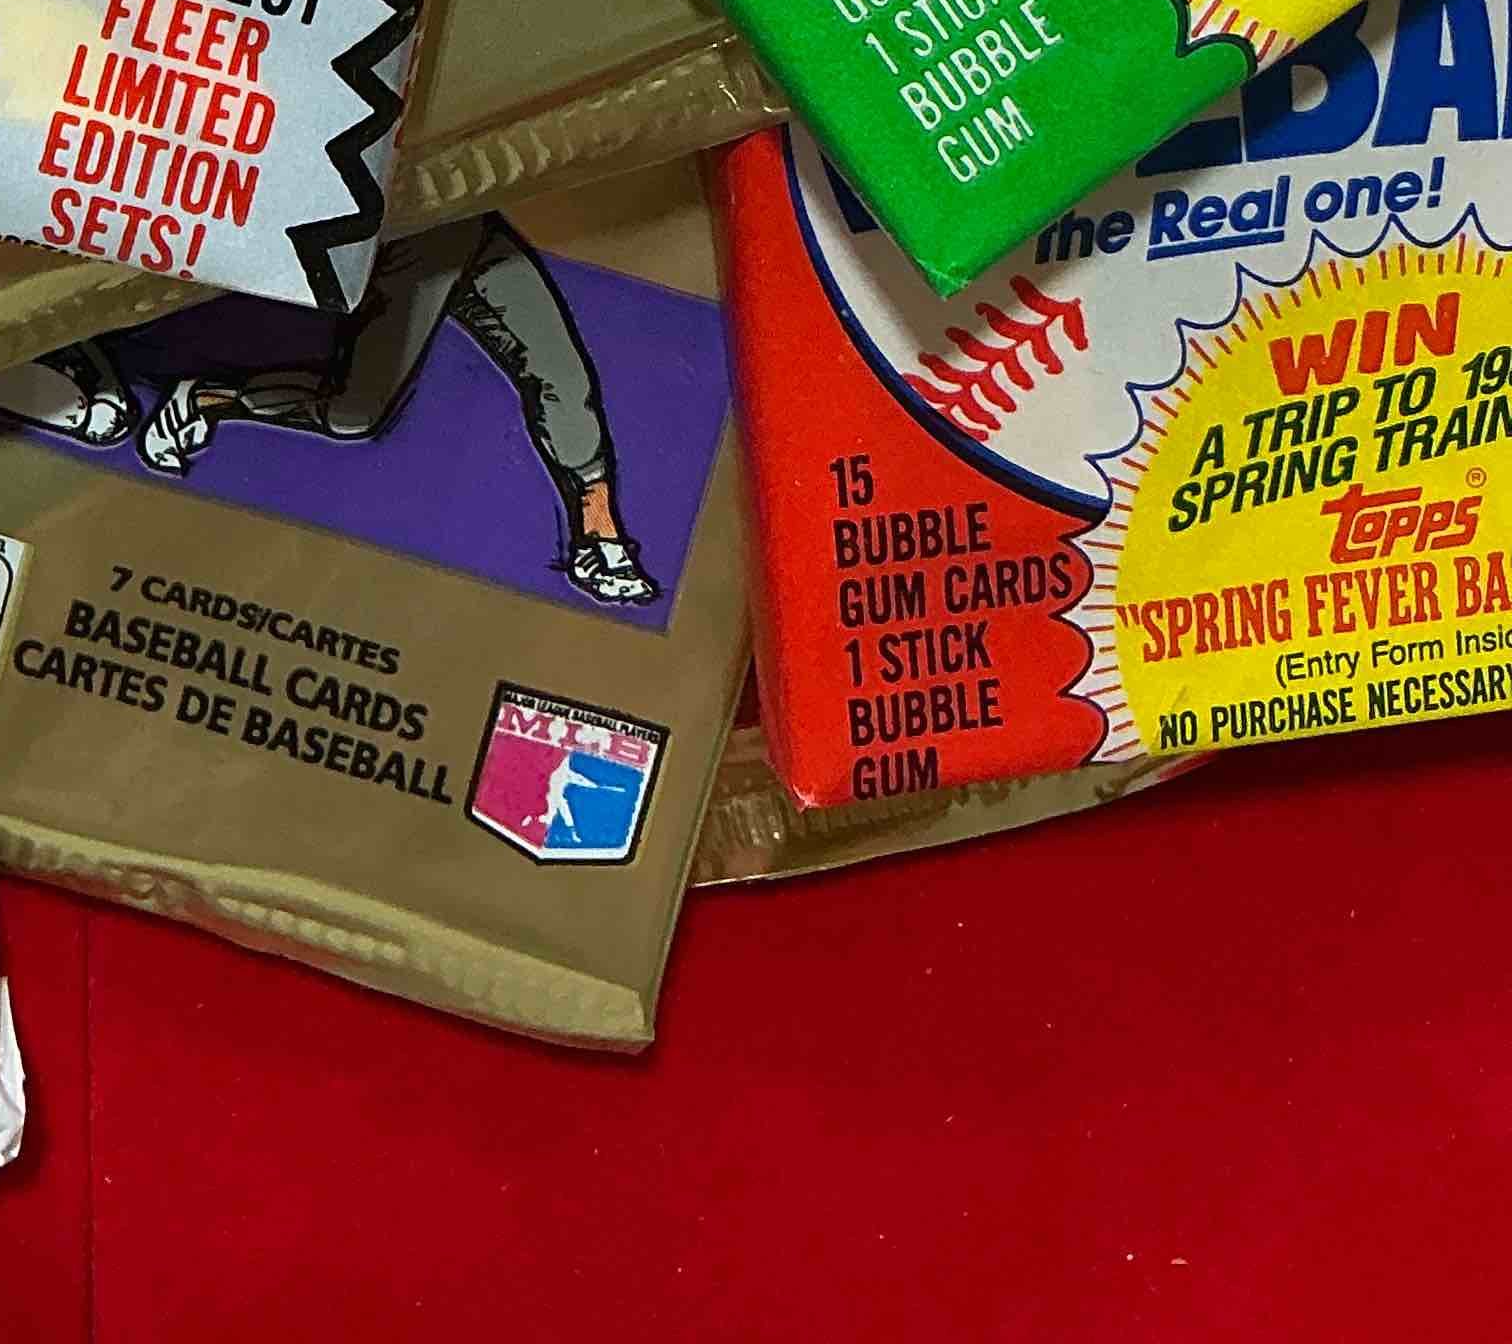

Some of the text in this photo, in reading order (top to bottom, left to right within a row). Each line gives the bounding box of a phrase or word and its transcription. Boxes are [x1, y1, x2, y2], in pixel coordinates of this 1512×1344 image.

[61, 42, 277, 158] LIMITED
[934, 96, 1036, 185] GUM
[37, 111, 262, 229] EDITION
[1146, 156, 1447, 262] Real one!
[39, 188, 208, 282] SETS!
[1267, 291, 1462, 397] WIN
[1189, 365, 1438, 478] A TRIP TO
[828, 453, 876, 507] 15
[1167, 436, 1359, 535] SPRING
[833, 501, 993, 570] BUBBLE
[141, 575, 402, 675] CARDS/CARTES
[837, 551, 1076, 630] GUM CARDS
[1303, 560, 1445, 638] FEVER
[63, 600, 430, 742] BASEBALL CARDS
[877, 623, 994, 683] STICK
[1275, 638, 1446, 690] (Entry Form
[12, 638, 455, 806] CARTES DE BASEBALL
[847, 677, 1004, 750] BUBBLE
[1158, 685, 1357, 750] NO PURCHASE
[850, 744, 941, 803] GUM
